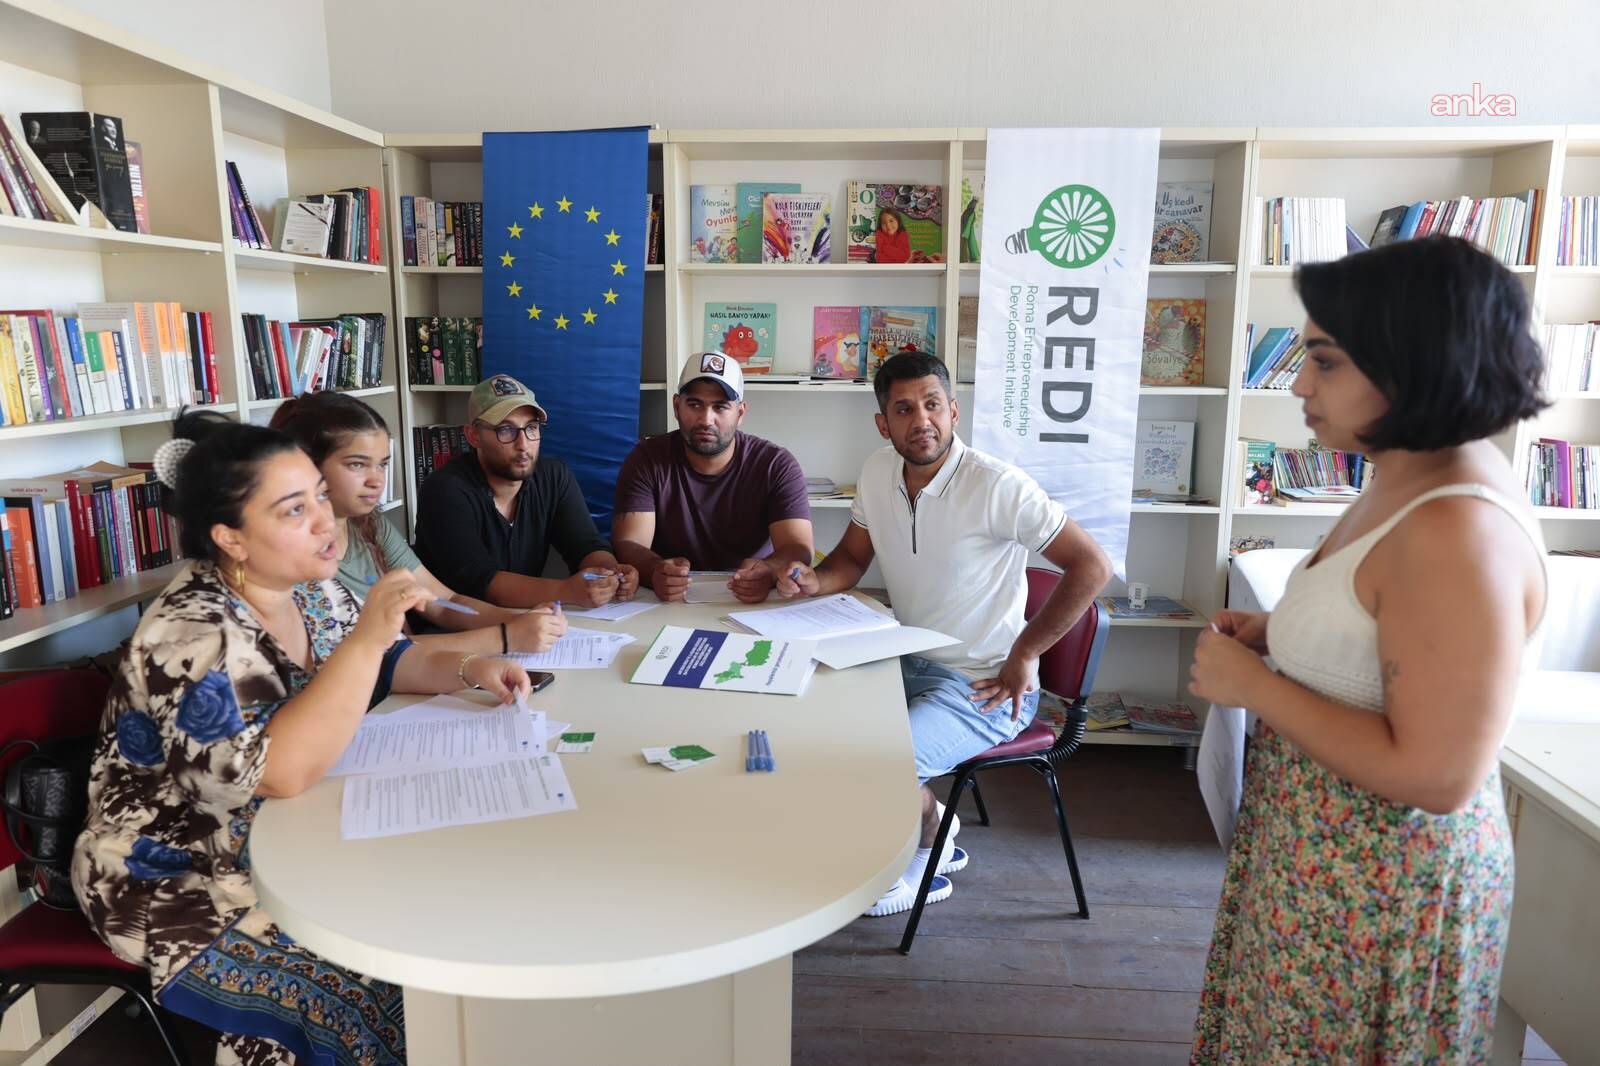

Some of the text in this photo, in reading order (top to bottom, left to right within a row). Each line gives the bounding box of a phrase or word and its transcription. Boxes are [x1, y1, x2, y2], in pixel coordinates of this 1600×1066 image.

[128, 163, 143, 198] NUTUK
[1003, 285, 1022, 428] Development Initiative
[1016, 285, 1039, 436] Roma Entrepreneurship
[1039, 286, 1099, 443] REDI
